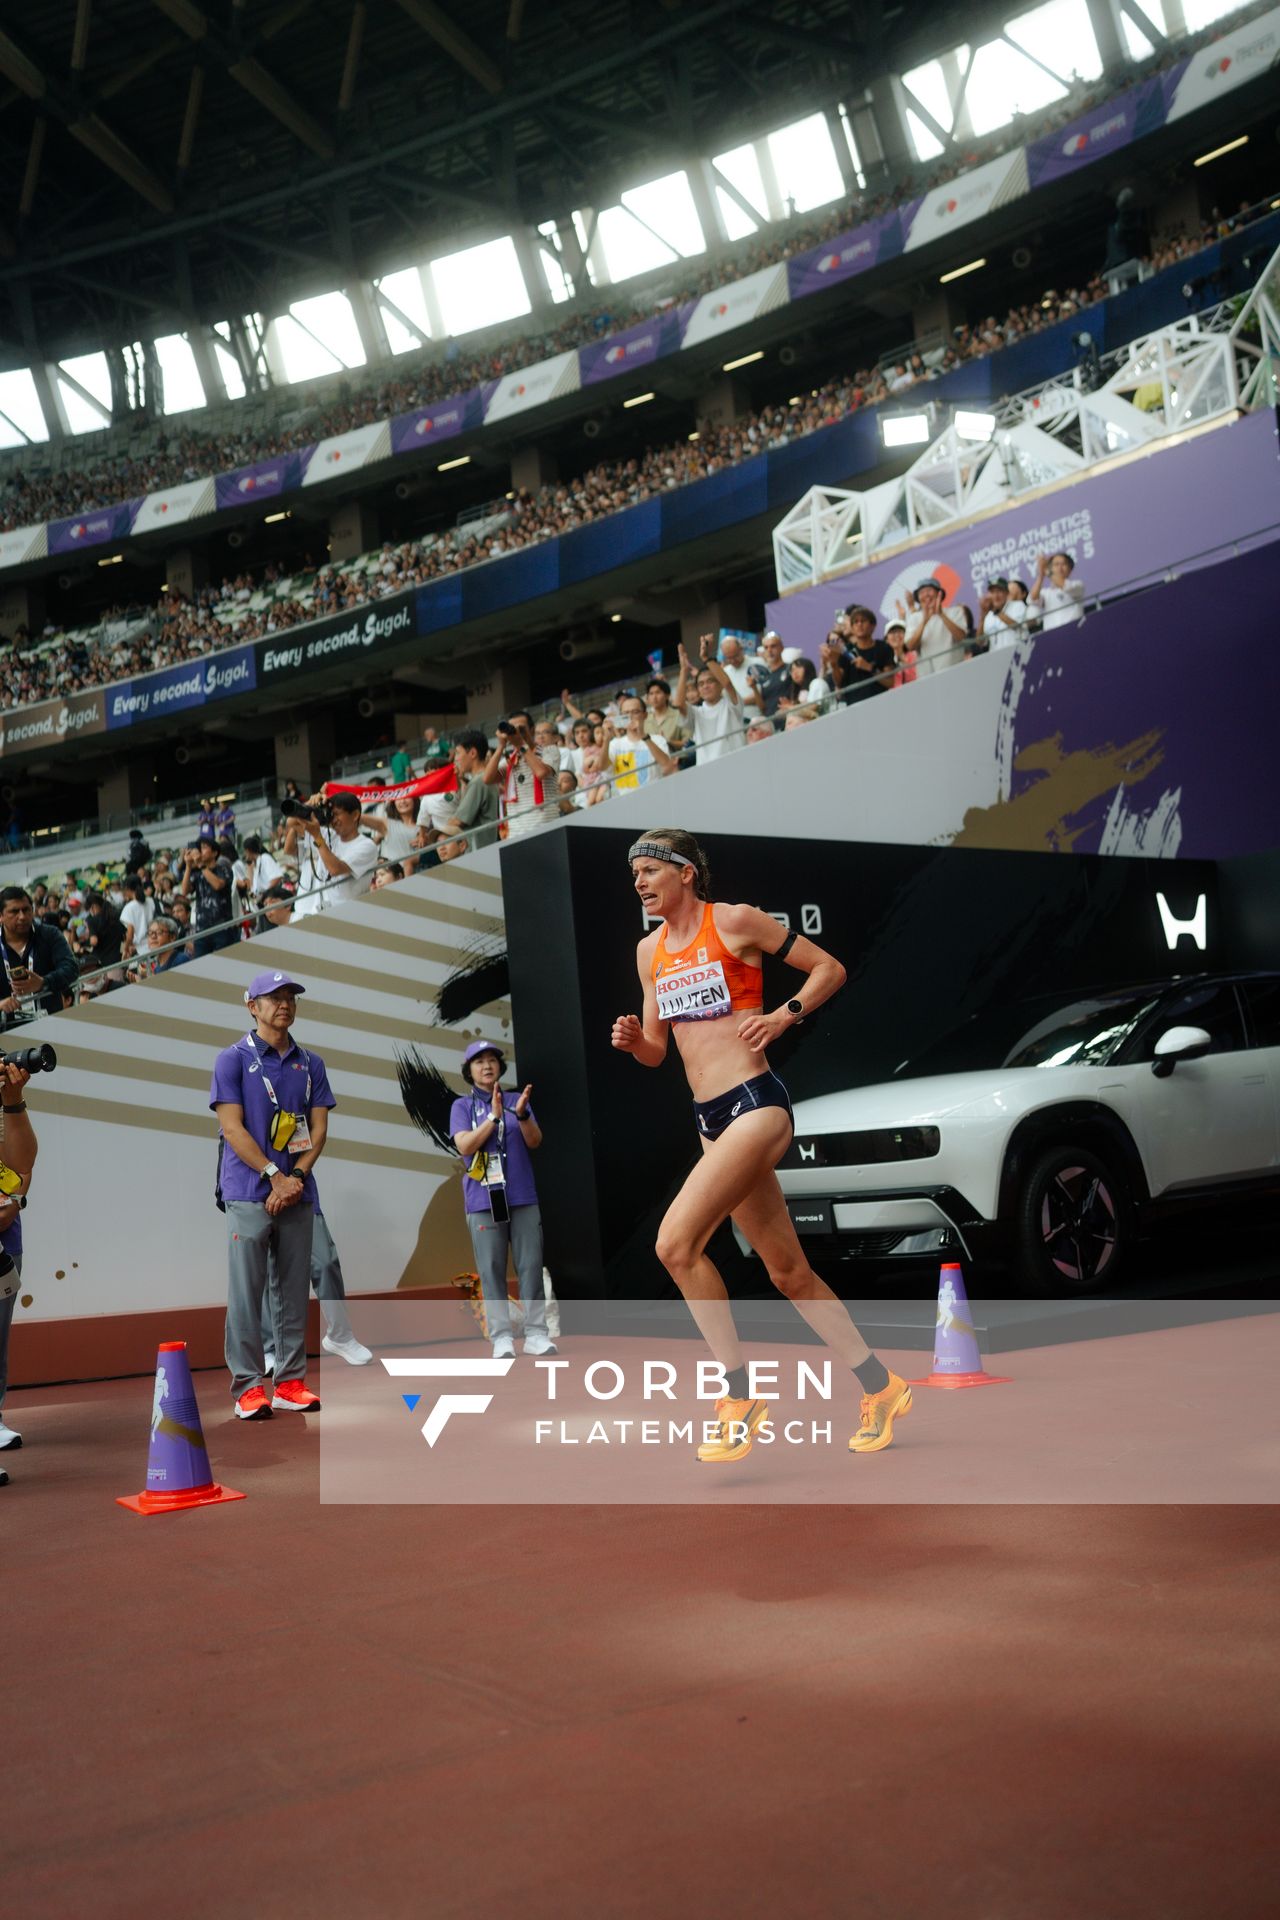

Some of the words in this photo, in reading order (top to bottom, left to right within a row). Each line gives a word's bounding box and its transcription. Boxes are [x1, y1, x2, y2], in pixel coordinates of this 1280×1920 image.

[969, 538, 1016, 564] WORLD
[1018, 509, 1091, 547] ATHLETICS
[263, 647, 303, 672] Every
[113, 693, 150, 716] Every
[657, 968, 721, 996] HONDA
